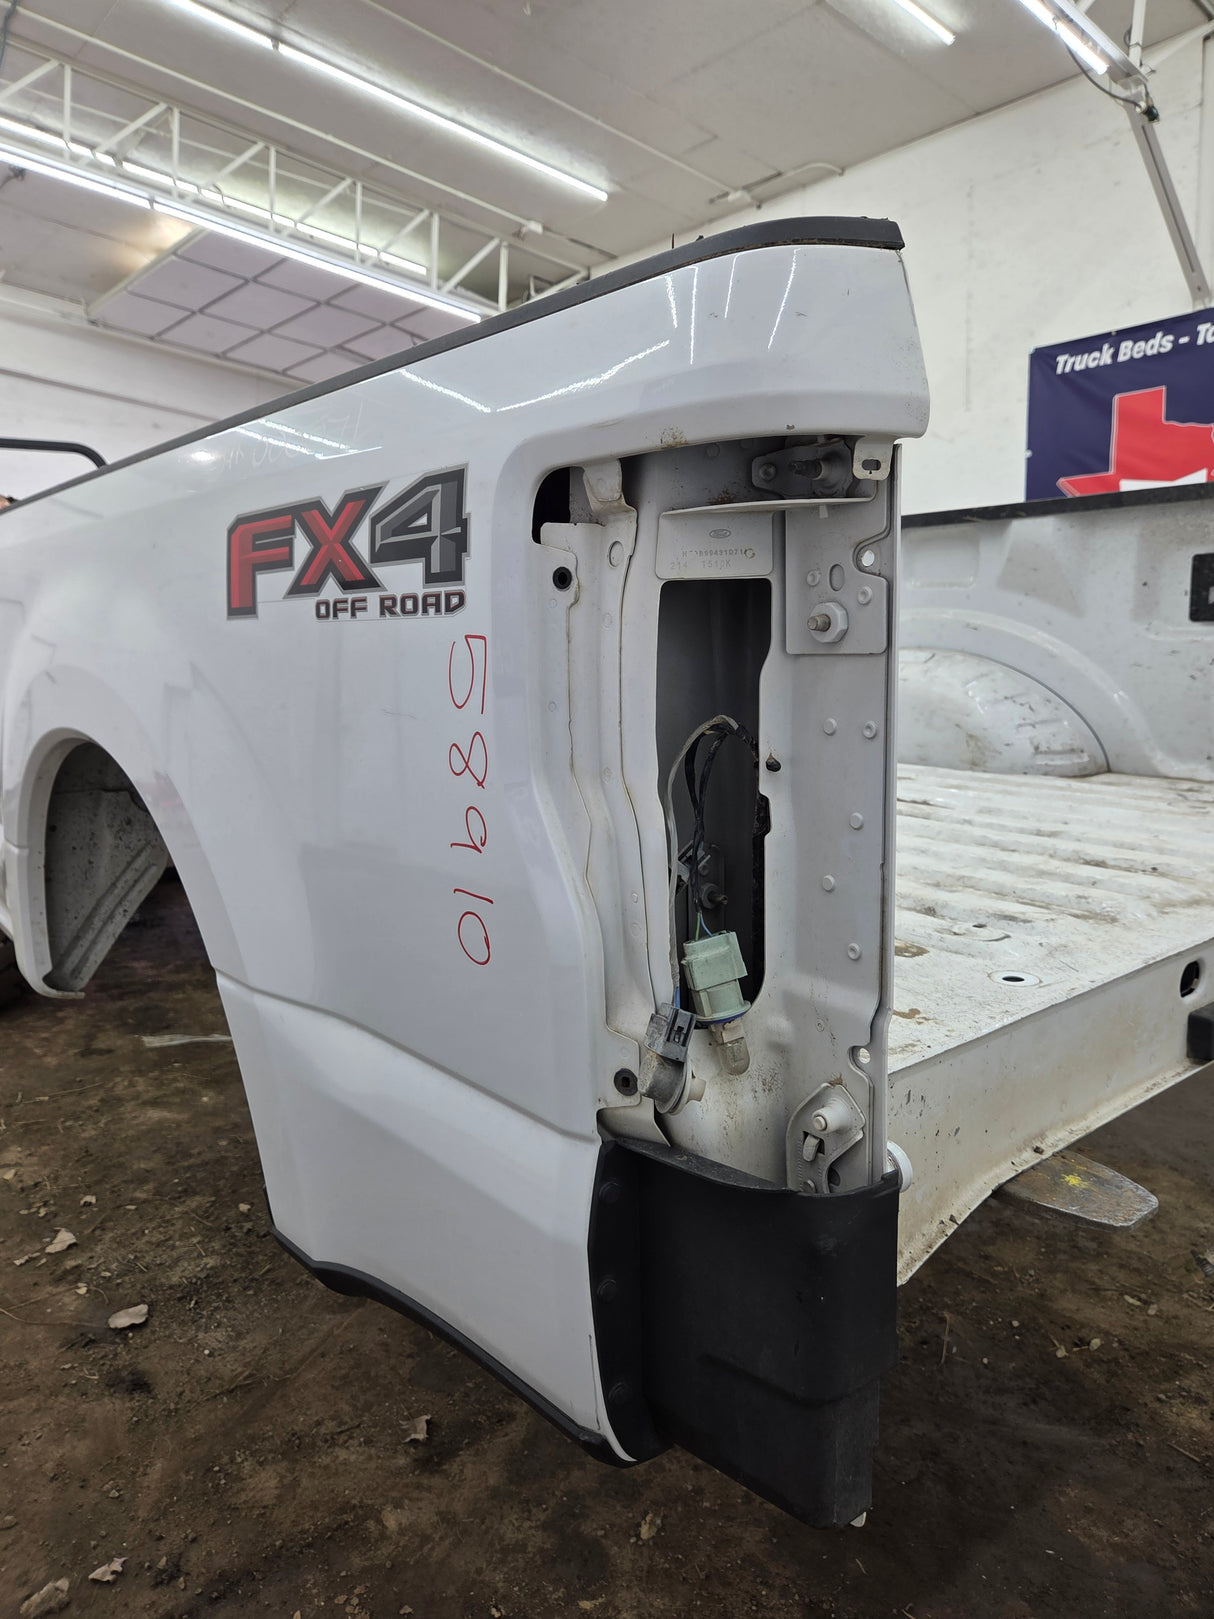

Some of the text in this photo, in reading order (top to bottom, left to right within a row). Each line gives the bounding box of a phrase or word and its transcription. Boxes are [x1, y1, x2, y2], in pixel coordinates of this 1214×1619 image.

[1056, 343, 1115, 375] Truck
[1117, 331, 1175, 363] Beds
[227, 462, 471, 620] FX4
[315, 590, 466, 620] OFF ROAD
